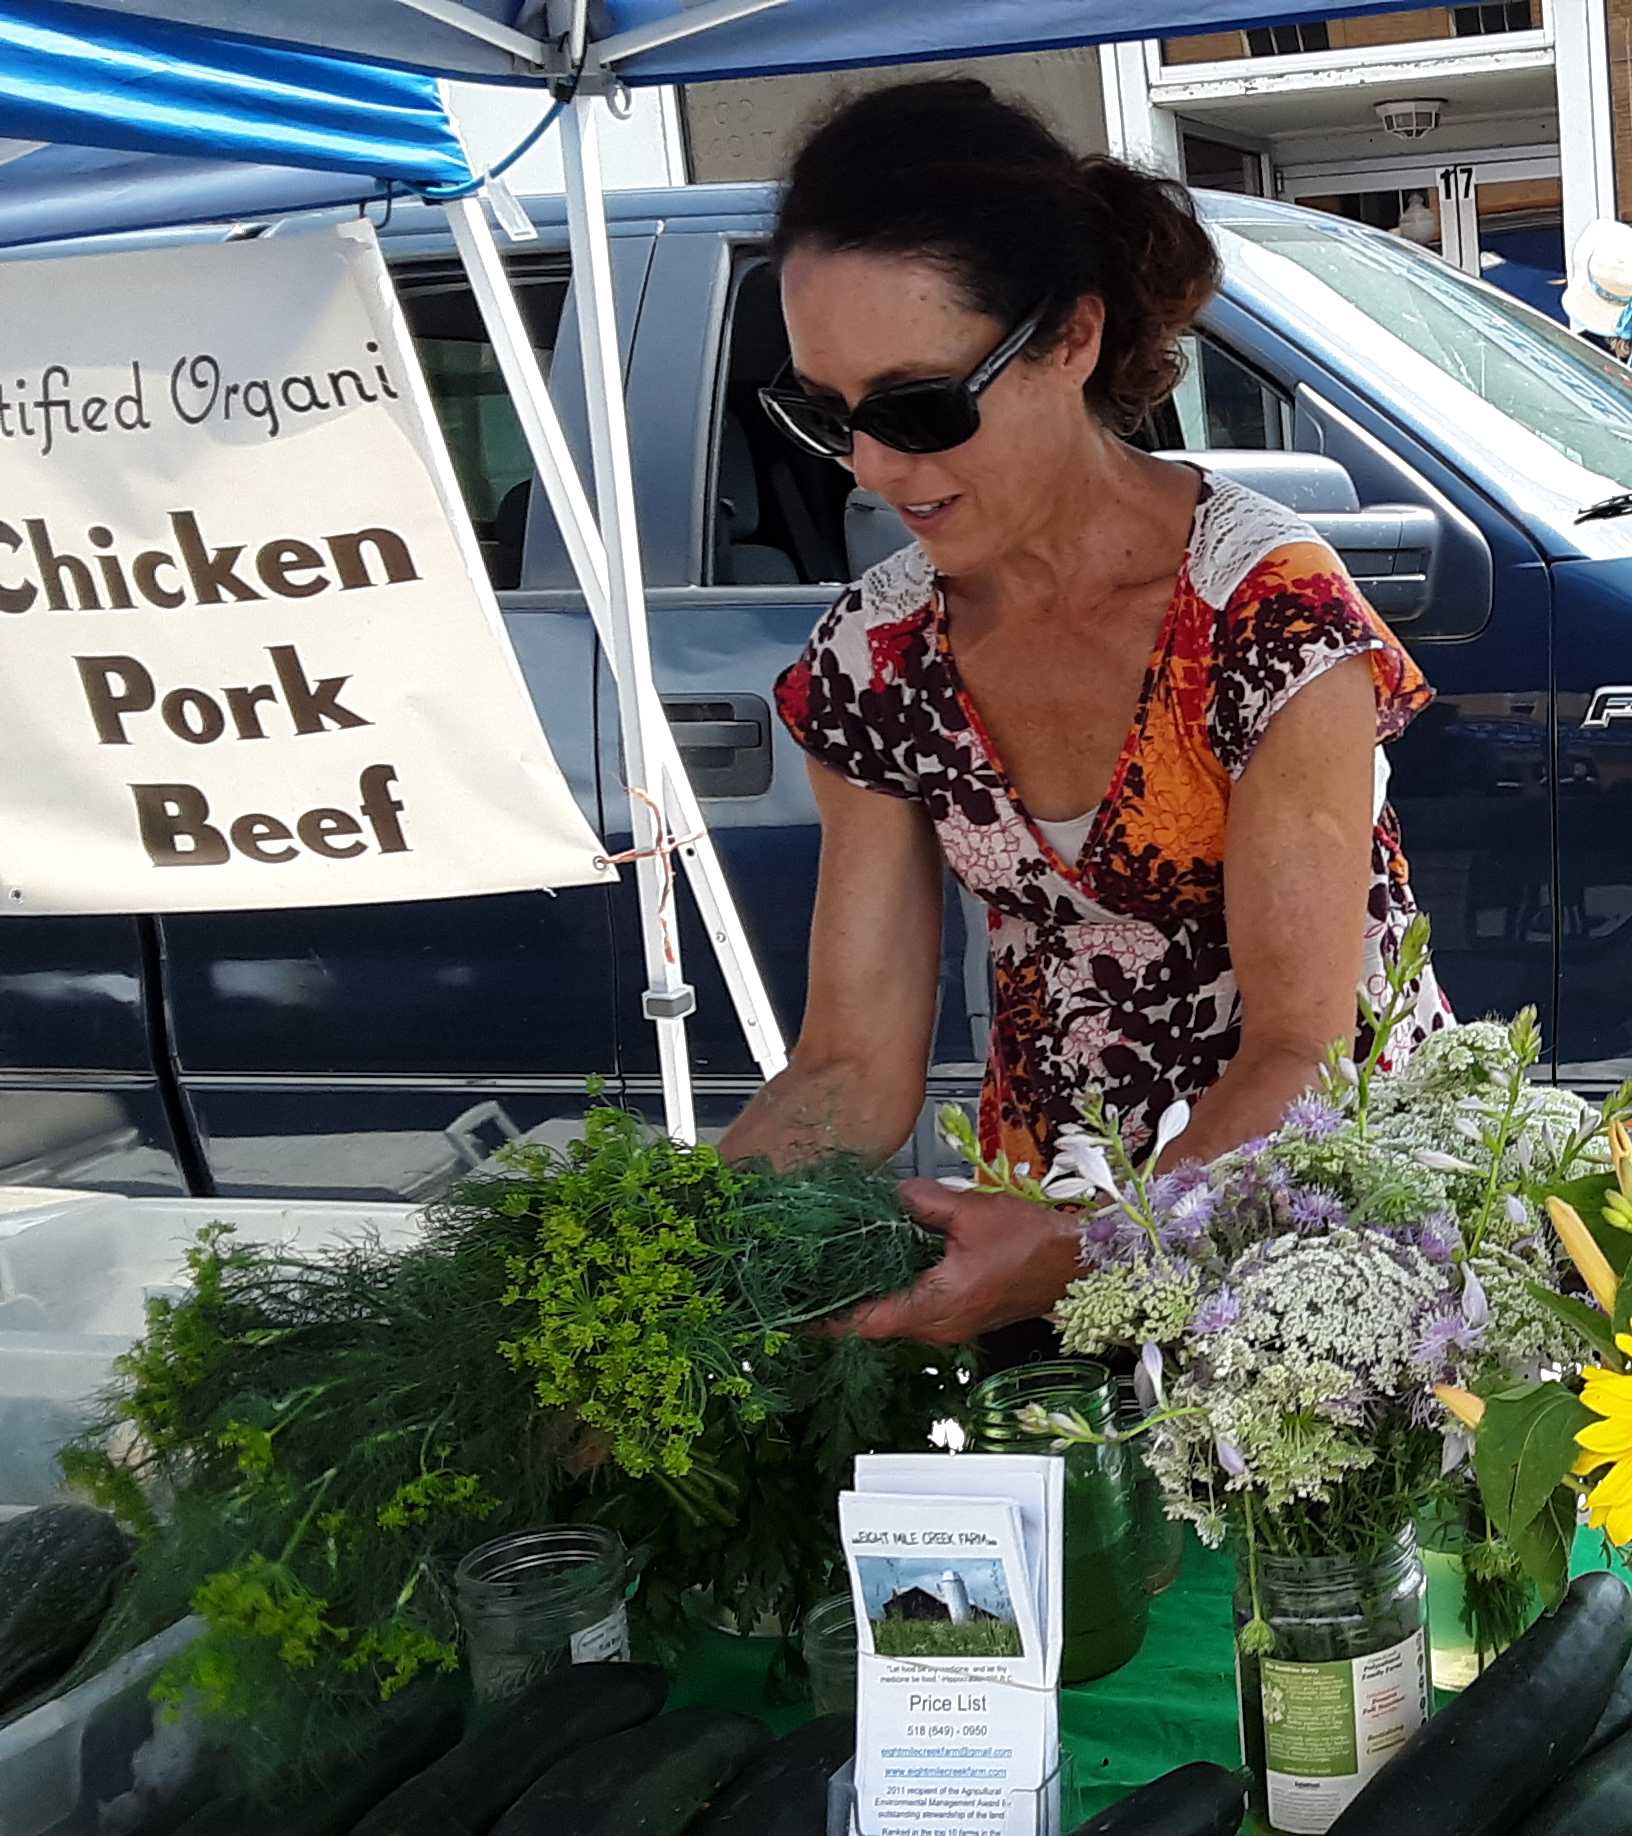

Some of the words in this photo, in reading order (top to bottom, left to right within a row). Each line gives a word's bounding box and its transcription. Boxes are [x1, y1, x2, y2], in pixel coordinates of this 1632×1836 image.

[1440, 167, 1473, 200] 17
[171, 341, 398, 438] Organi
[71, 644, 376, 745] Pork
[127, 764, 413, 868] Beef
[907, 1725, 926, 1736] 518
[962, 1725, 988, 1737] 0950
[909, 1694, 952, 1712] Price
[957, 1694, 987, 1712] List
